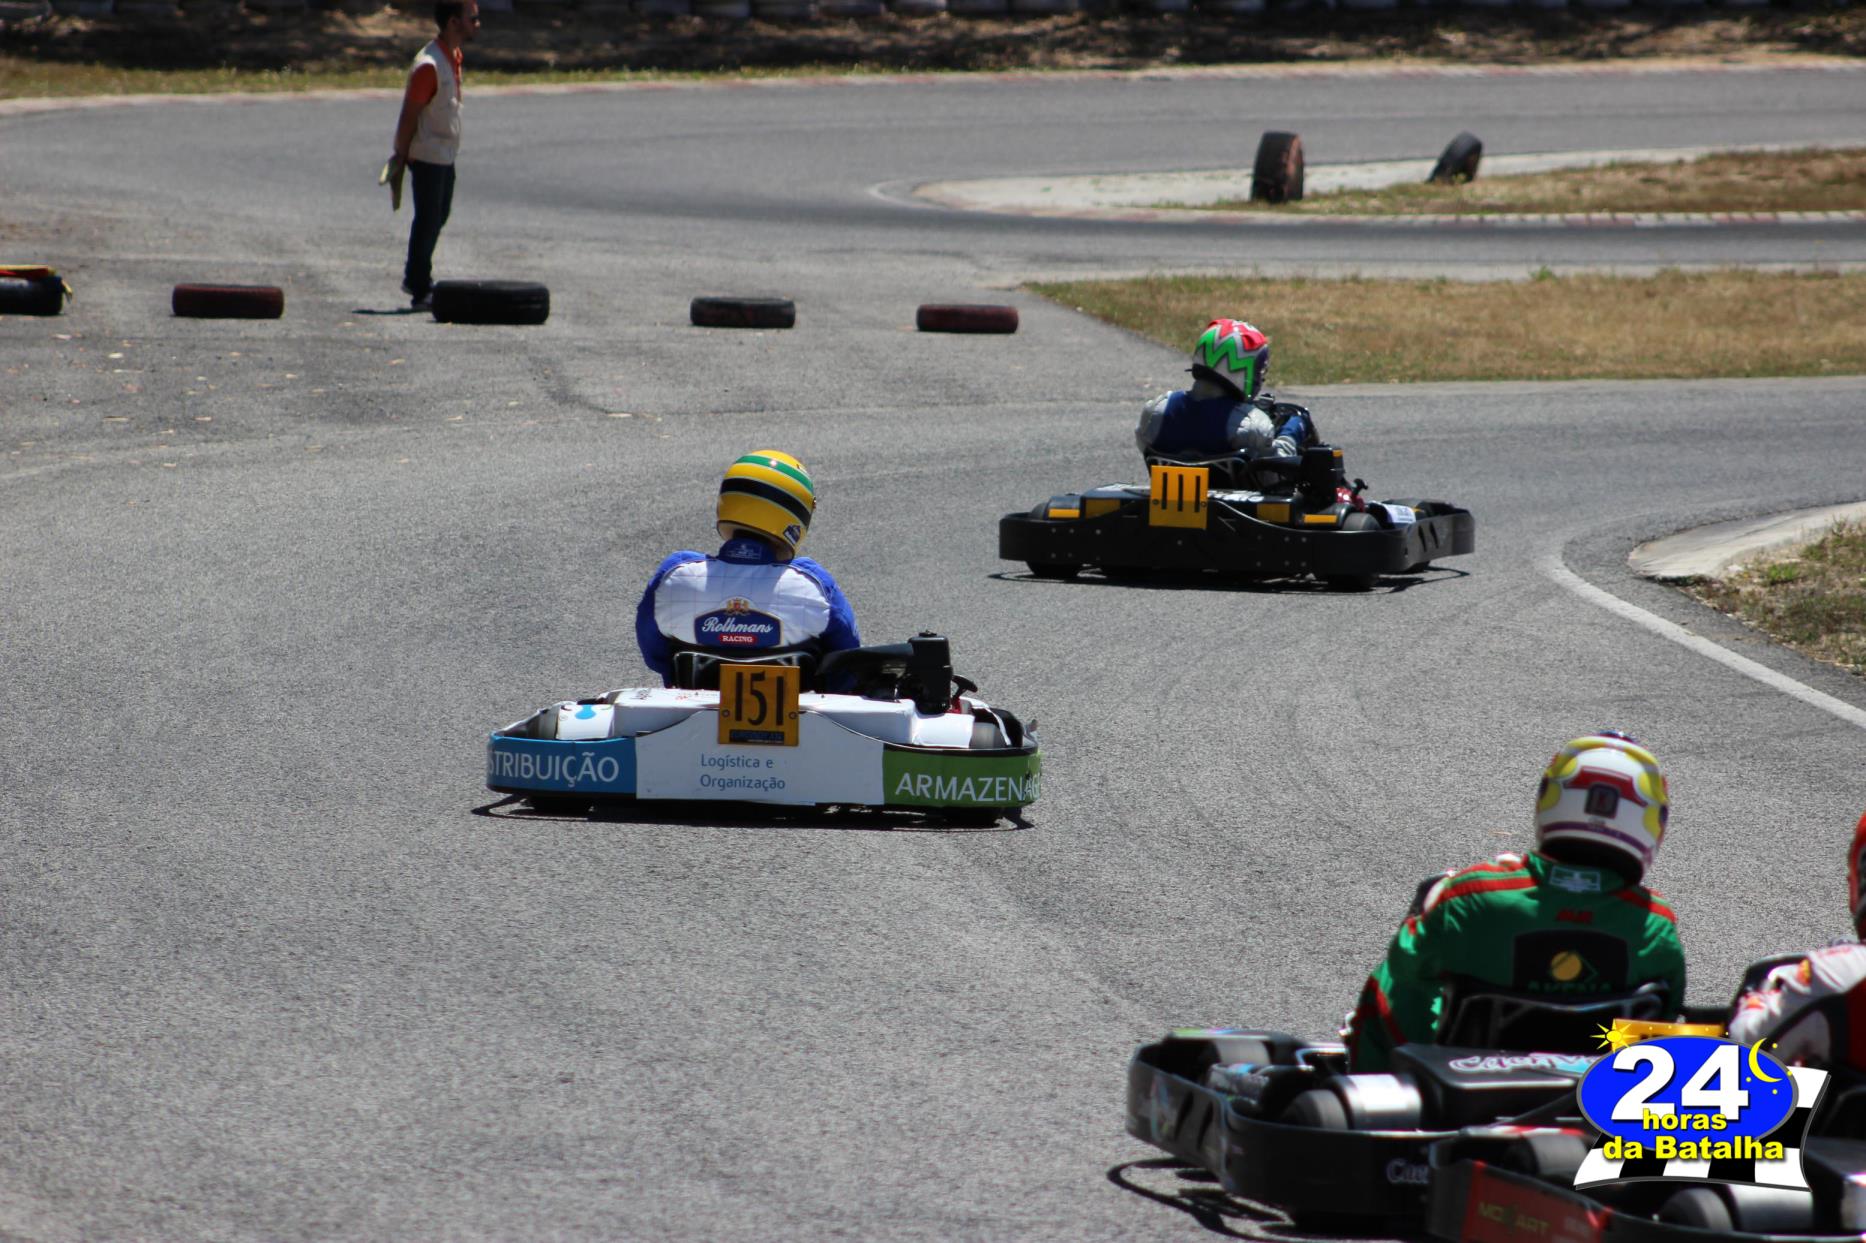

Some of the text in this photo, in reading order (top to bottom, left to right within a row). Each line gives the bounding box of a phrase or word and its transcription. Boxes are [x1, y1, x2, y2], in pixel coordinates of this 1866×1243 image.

[1161, 472, 1201, 513] 111
[702, 616, 774, 633] Rothmans
[722, 635, 753, 643] RACING
[735, 671, 784, 726] 151
[701, 754, 774, 771] Logística e
[700, 774, 786, 791] Organização
